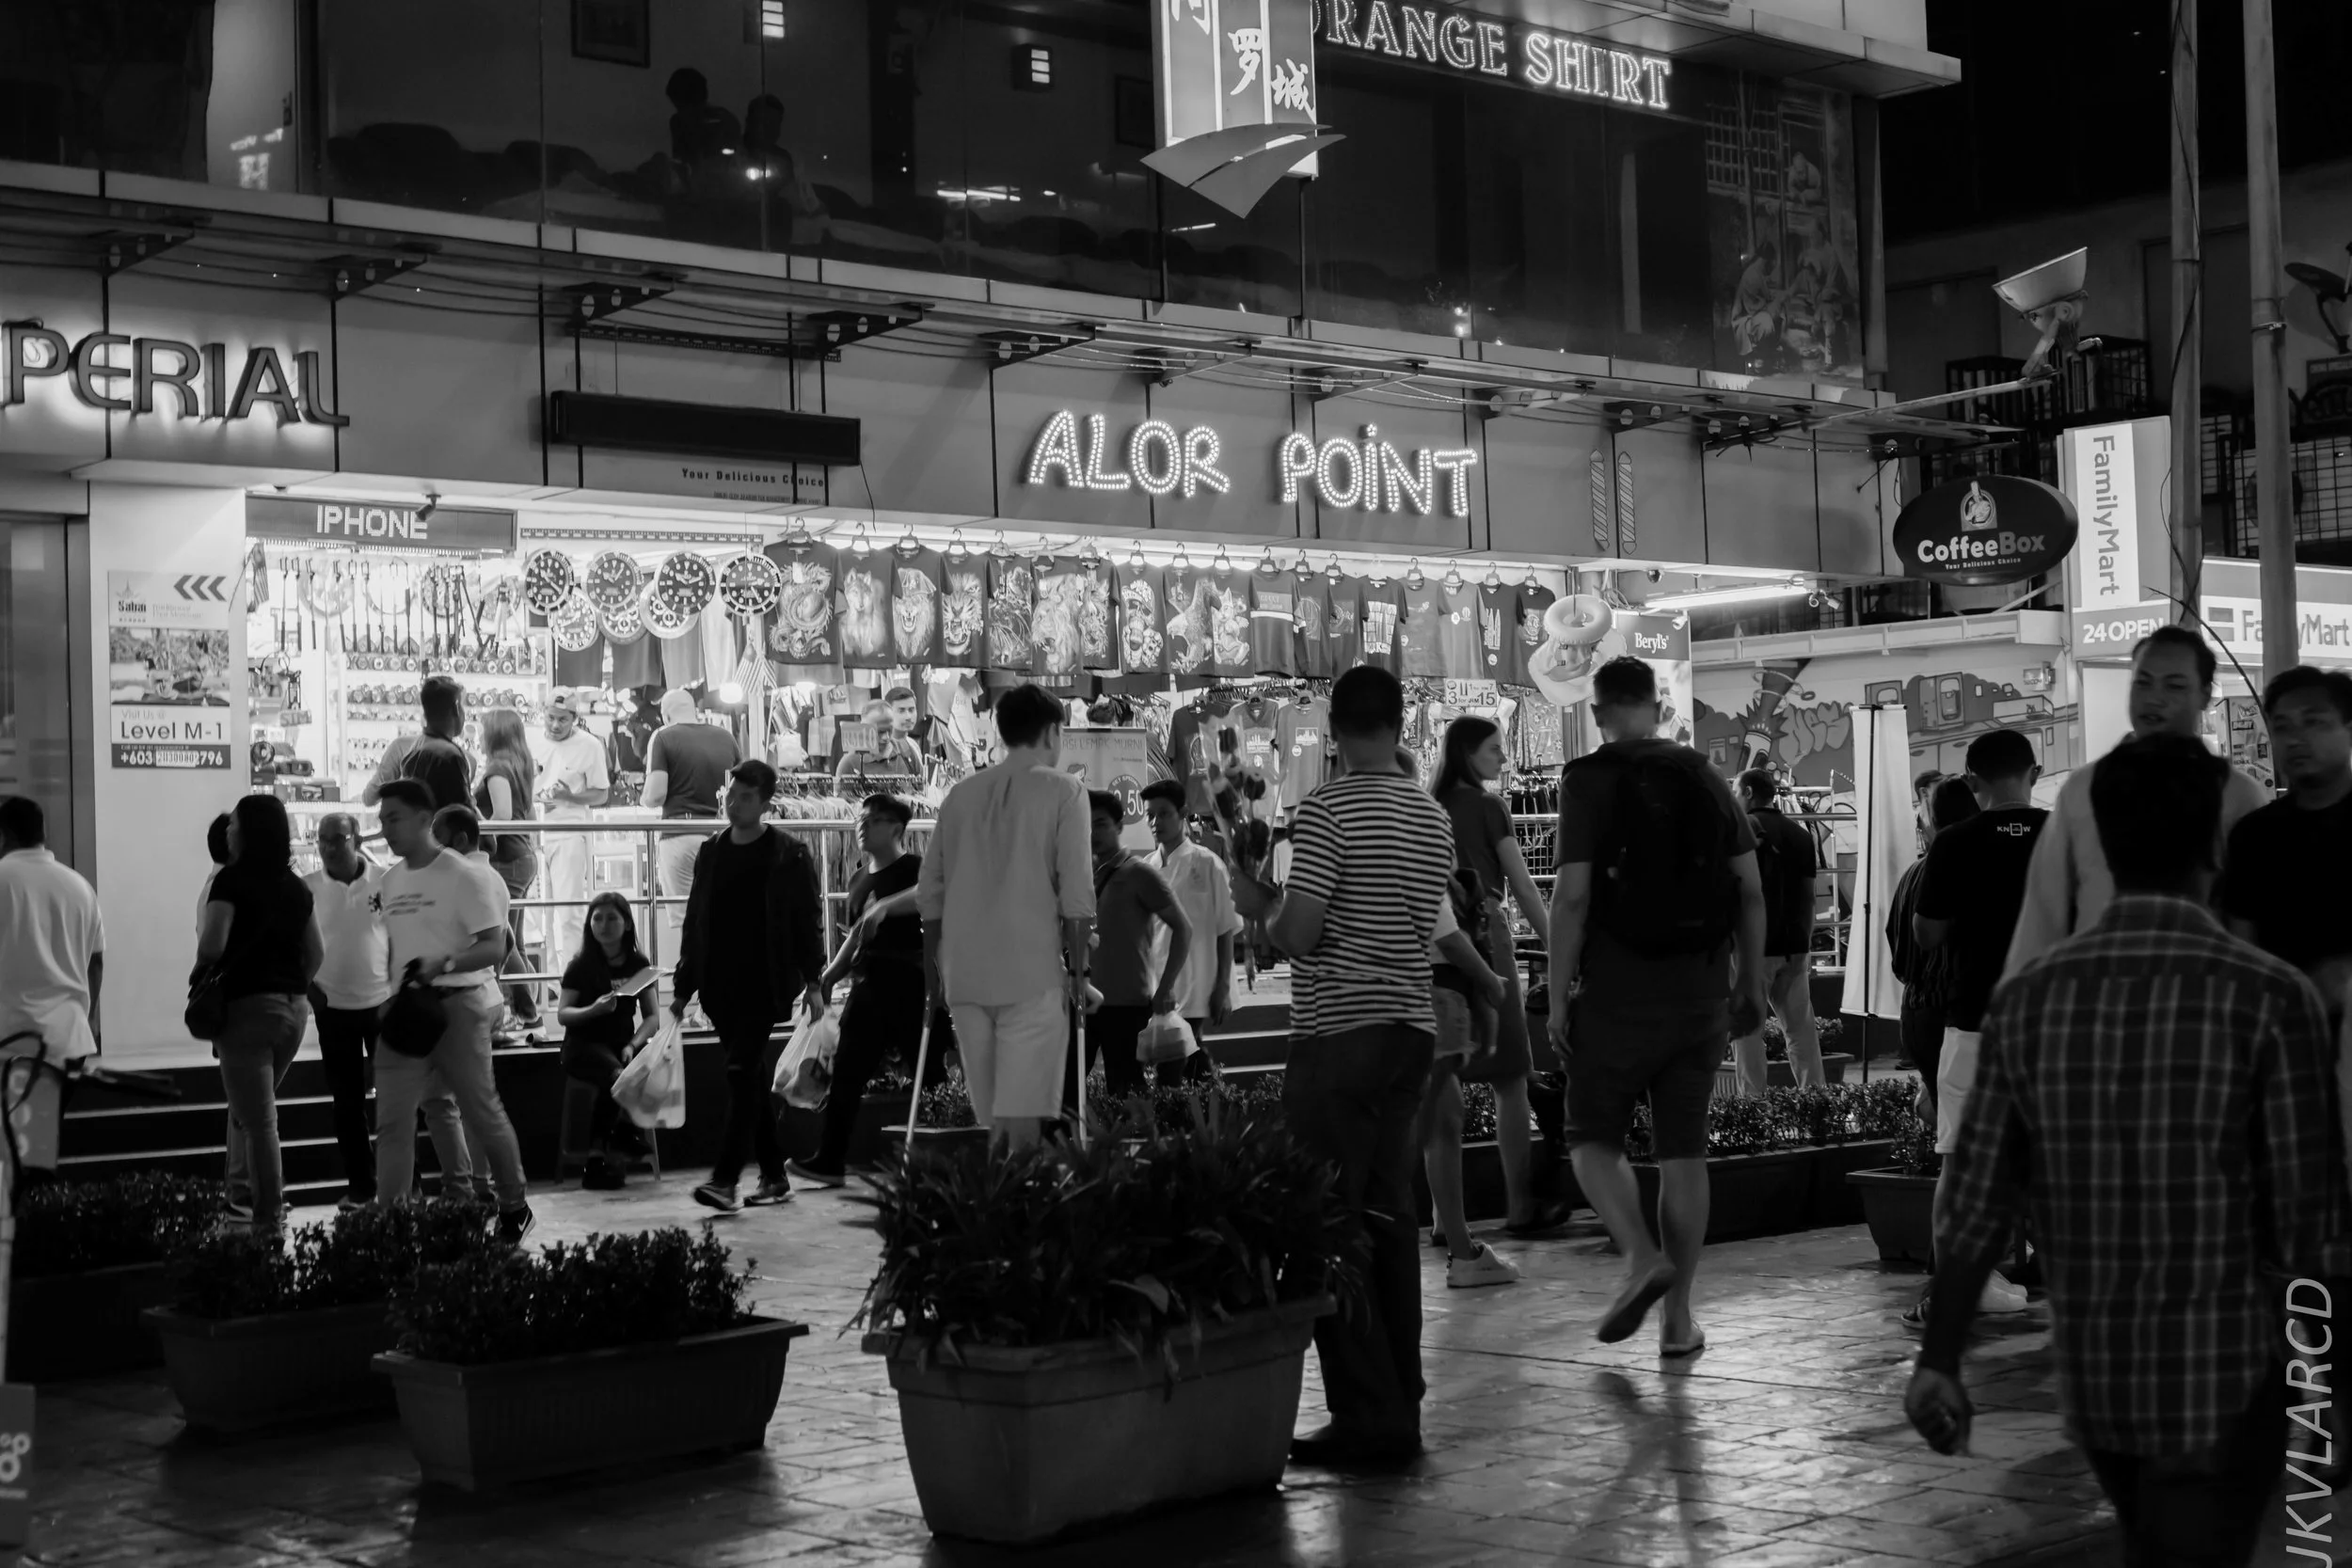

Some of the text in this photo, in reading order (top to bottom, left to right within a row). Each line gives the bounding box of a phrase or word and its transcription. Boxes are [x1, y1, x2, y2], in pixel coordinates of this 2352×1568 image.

[1313, 0, 1671, 110] RANGE SHIRT
[2, 325, 350, 428] PERIAL
[1029, 409, 1231, 499] ALOR
[682, 468, 709, 480] Your
[716, 470, 776, 484] Delicious
[316, 504, 428, 540] IPHONE
[2093, 435, 2120, 595] FamilyMart
[1917, 531, 2046, 563] CoffeeBox
[1963, 560, 1995, 569] Delicious
[1997, 557, 2022, 565] Choice
[1634, 632, 1669, 653] Beryl's
[1449, 690, 1457, 705] 3
[121, 721, 222, 739] Level M-1
[120, 750, 153, 766] +603
